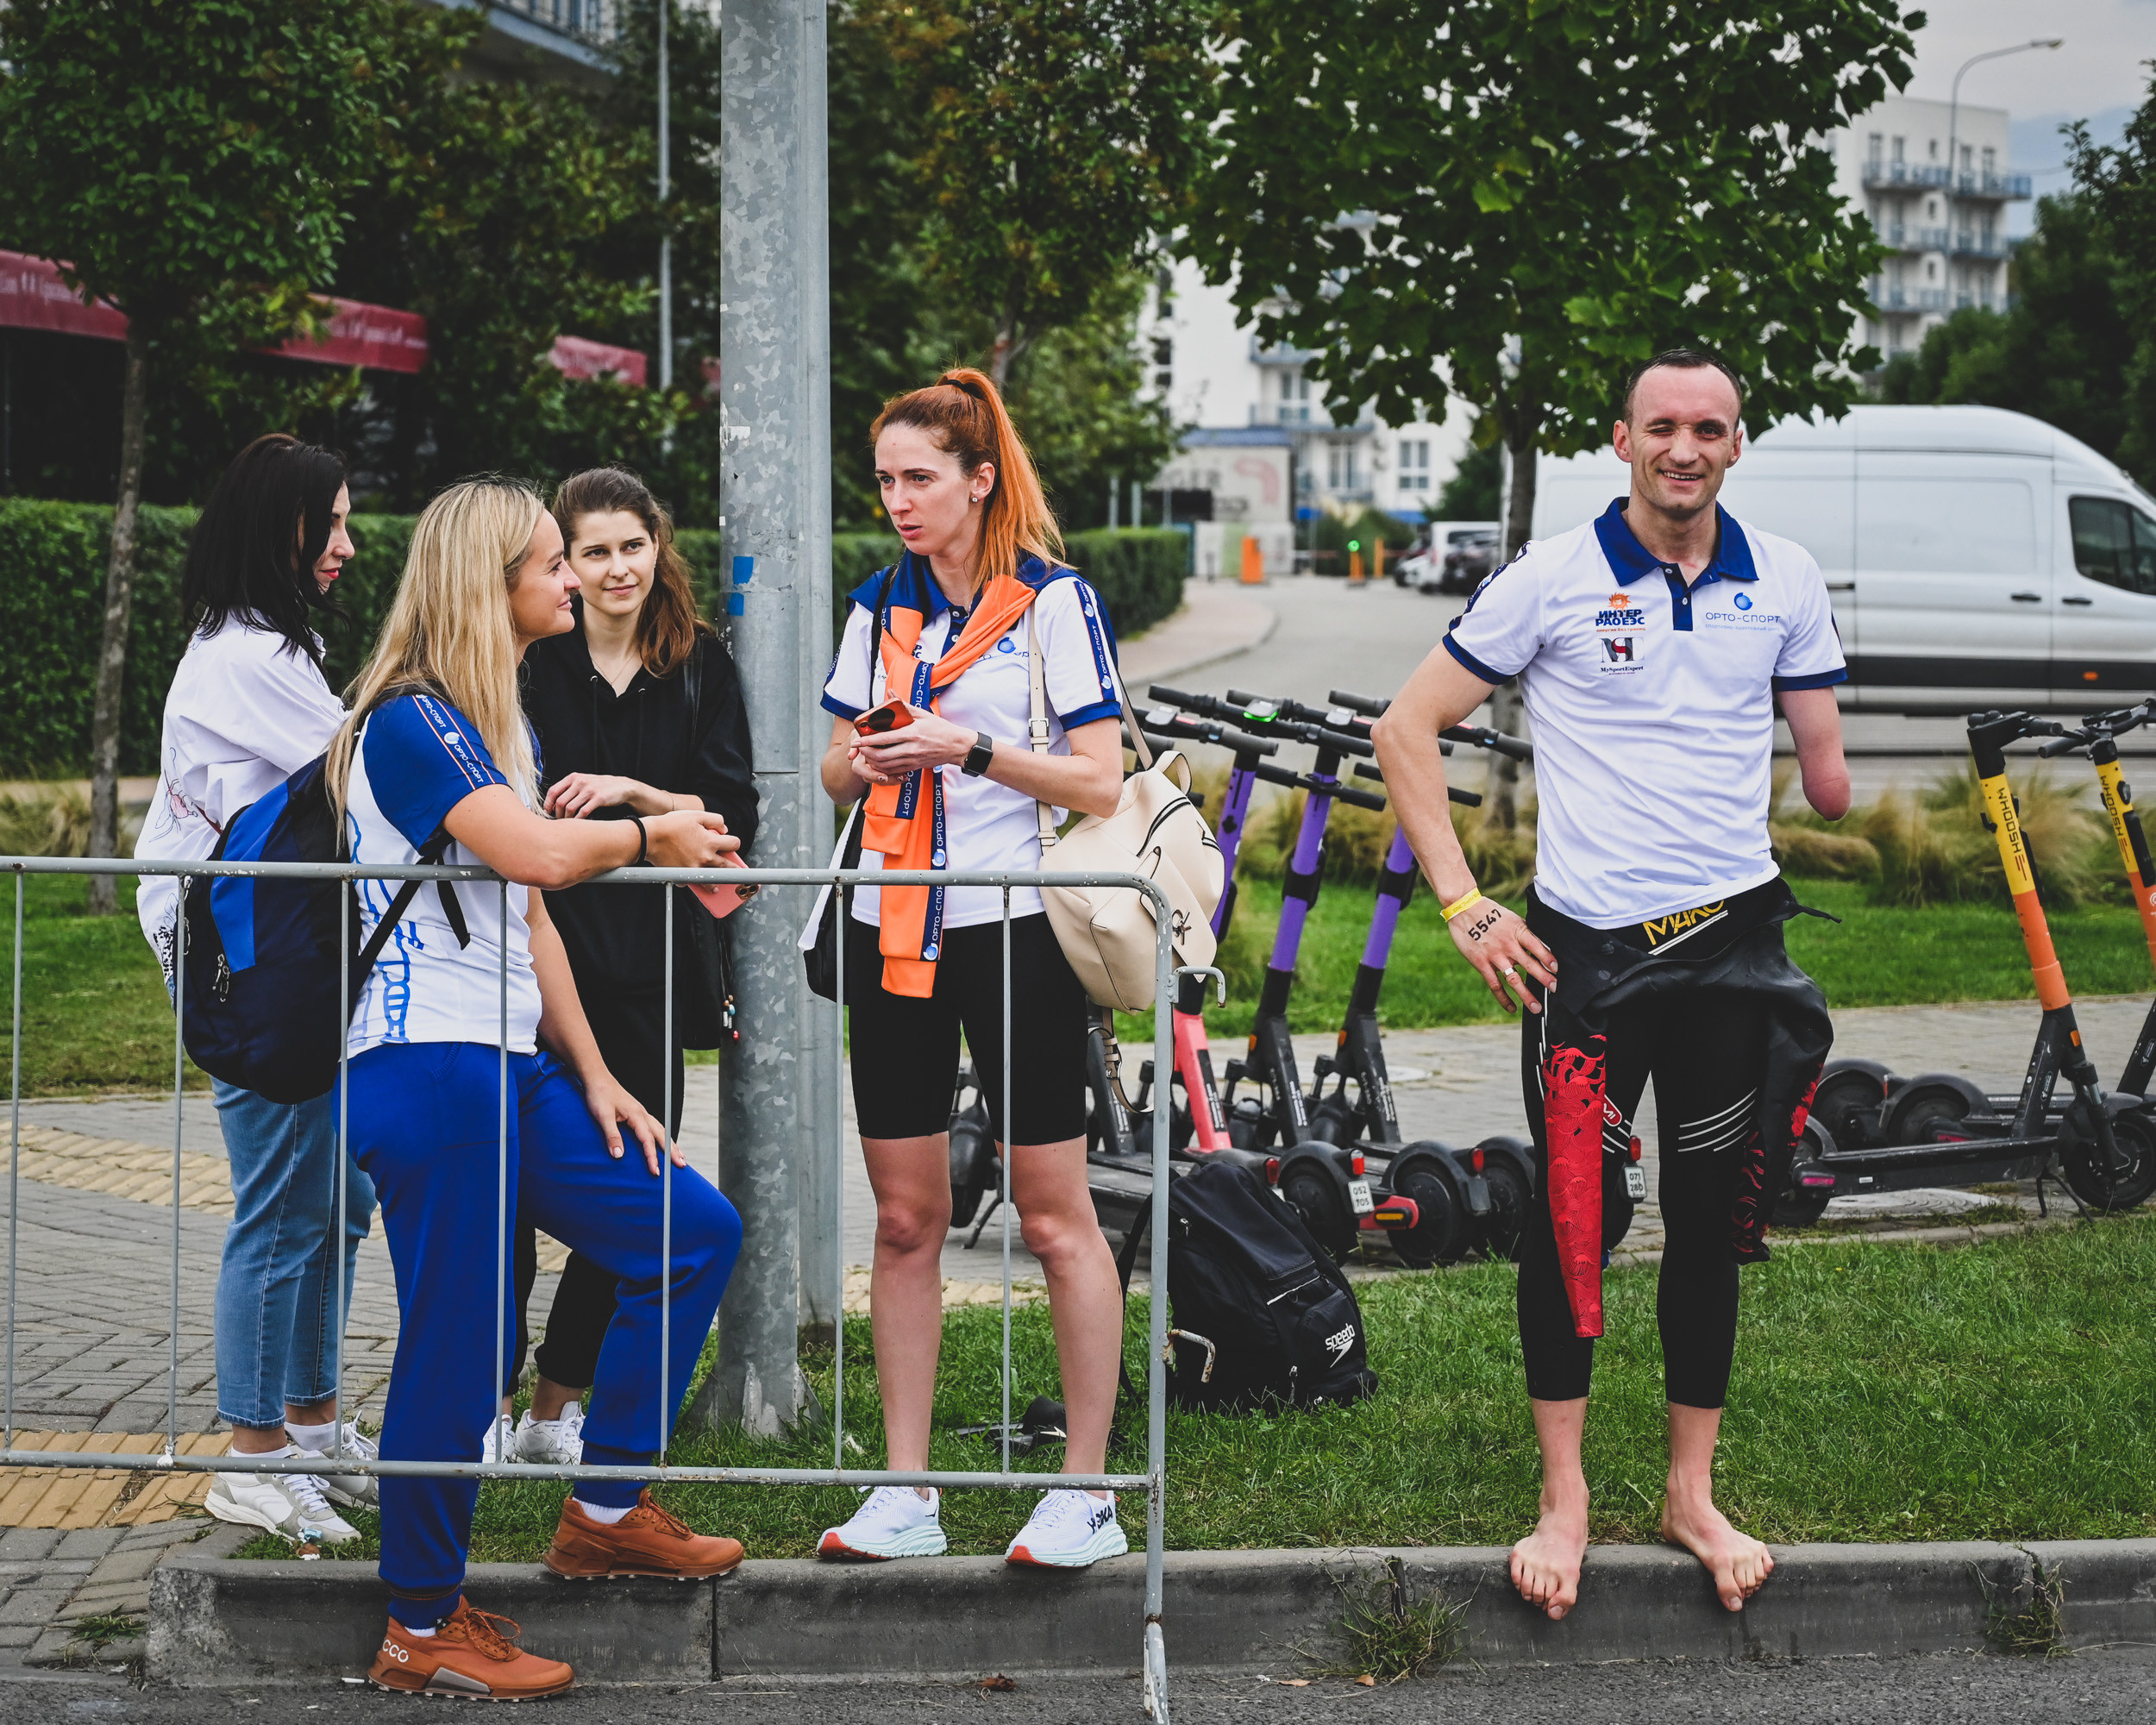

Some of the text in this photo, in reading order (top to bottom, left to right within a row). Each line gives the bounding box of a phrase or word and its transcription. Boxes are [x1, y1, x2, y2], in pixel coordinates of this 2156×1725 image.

[1598, 609, 1643, 618] ИНТЕР
[1705, 612, 1781, 624] ОРТО-СПОРТ
[914, 663, 929, 709] ОРТО-СПО
[454, 744, 484, 783] ОРТО-СПОРТ
[935, 783, 943, 847] ОРТО-СПОРТ
[1997, 787, 2022, 854] WHOOSH
[2100, 775, 2124, 837] WHOOSH
[931, 885, 943, 941] ОРТО-СПОР
[1468, 908, 1502, 941] 5547
[1325, 1322, 1356, 1353] speedo
[1087, 1504, 1113, 1535] HOKA
